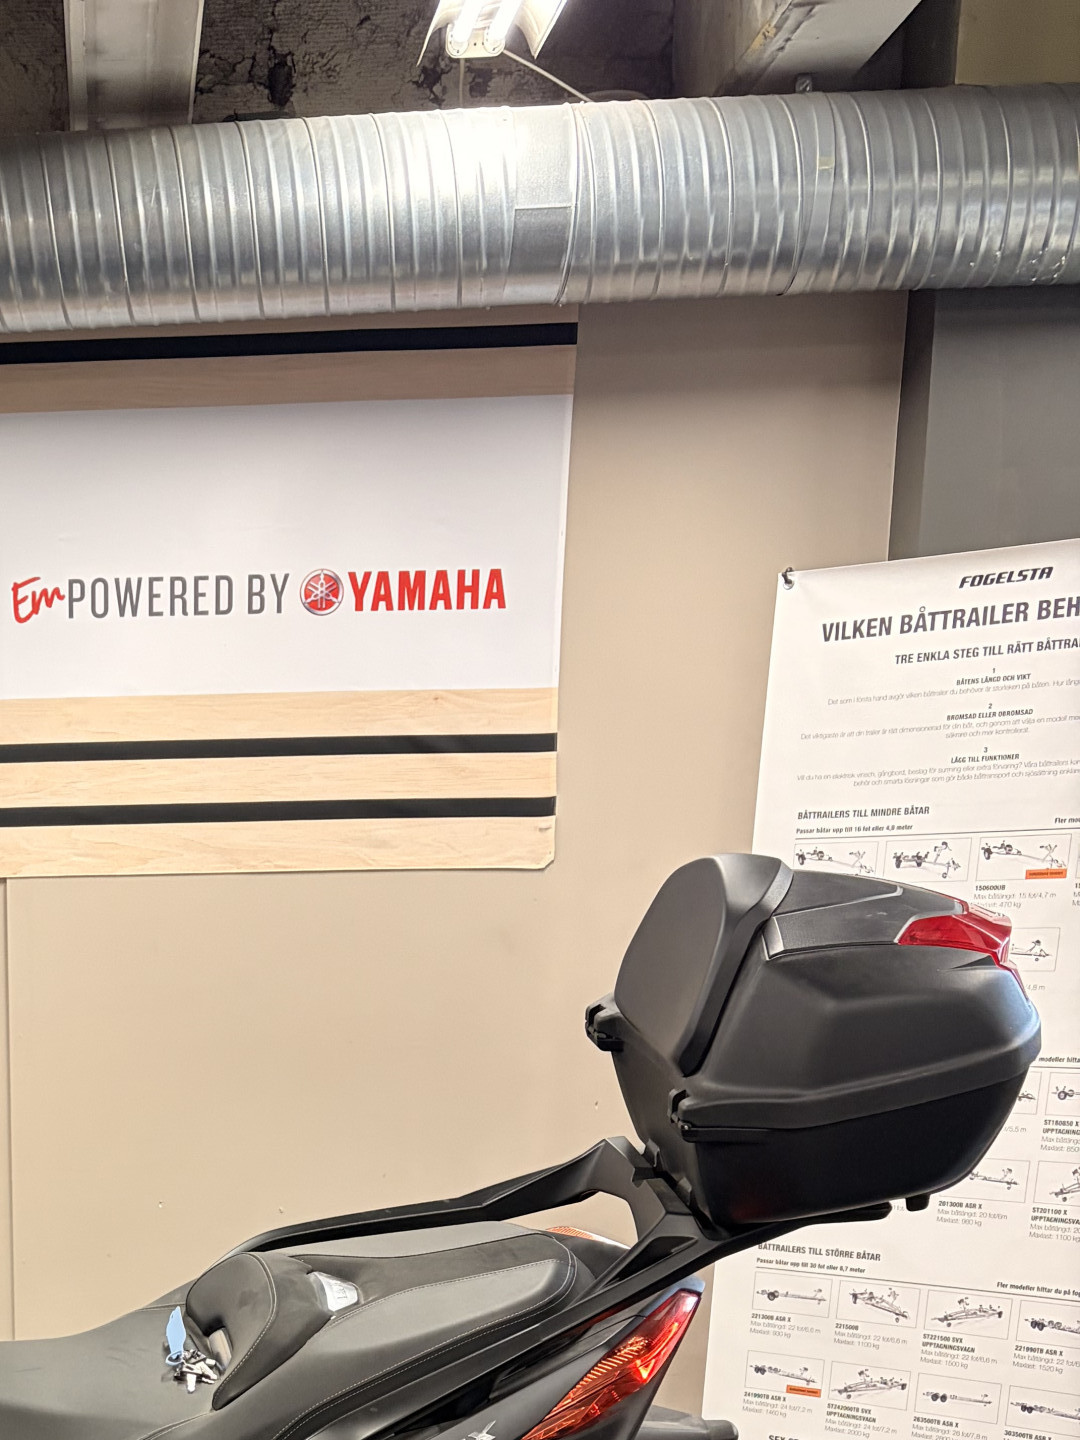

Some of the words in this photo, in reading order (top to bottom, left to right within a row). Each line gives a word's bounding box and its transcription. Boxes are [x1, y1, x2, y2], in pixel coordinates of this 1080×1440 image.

[959, 567, 1053, 588] FOGELSTA
[247, 573, 290, 614] BY
[348, 568, 507, 612] YAMAHA
[823, 616, 892, 642] VILKEN
[900, 602, 1029, 634] BÅTTRAILER
[1037, 596, 1080, 620] BEH
[895, 654, 914, 664] TRE
[917, 650, 950, 662] ENKLA
[953, 647, 979, 659] STEG
[982, 645, 1004, 656] TILL
[1007, 641, 1034, 654] RÄTT
[946, 713, 977, 721] BROMSAD
[998, 709, 1034, 717] OBROMSAD
[981, 754, 1020, 762] FUNKTIONER
[798, 810, 850, 820] BÅTTRAILERS
[852, 809, 868, 818] TILL
[870, 808, 901, 817] MINDRE
[904, 805, 930, 815] BÅTAR
[808, 1247, 823, 1255] TILL
[825, 1248, 854, 1258] STÖRRE
[856, 1250, 881, 1261] BÅTAR
